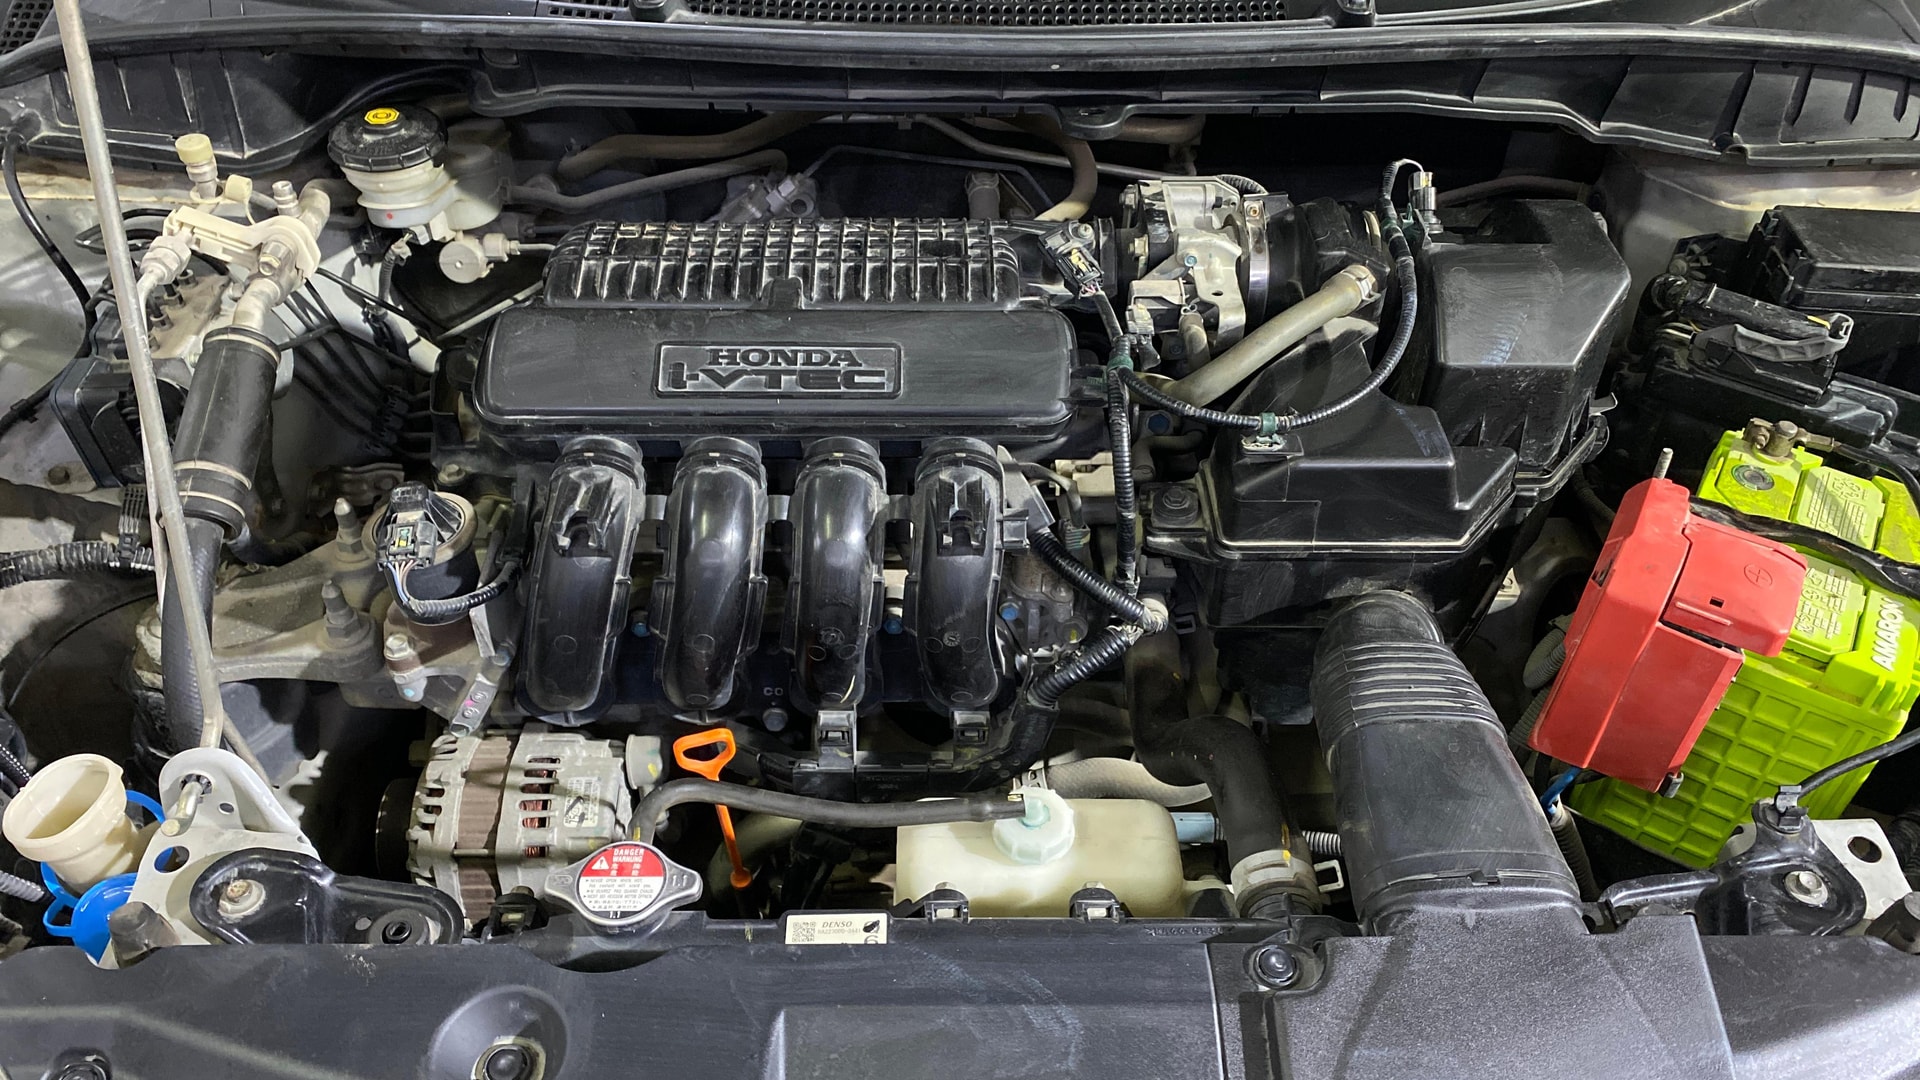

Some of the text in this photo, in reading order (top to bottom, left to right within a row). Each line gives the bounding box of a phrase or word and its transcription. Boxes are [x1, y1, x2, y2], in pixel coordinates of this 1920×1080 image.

[706, 348, 862, 367] HONDA
[669, 362, 886, 390] i-VTEC
[1871, 596, 1905, 672] AMARON
[613, 848, 644, 856] DANGER
[672, 875, 689, 887] 1.1
[609, 911, 621, 919] 1.1
[822, 920, 853, 928] DENSO
